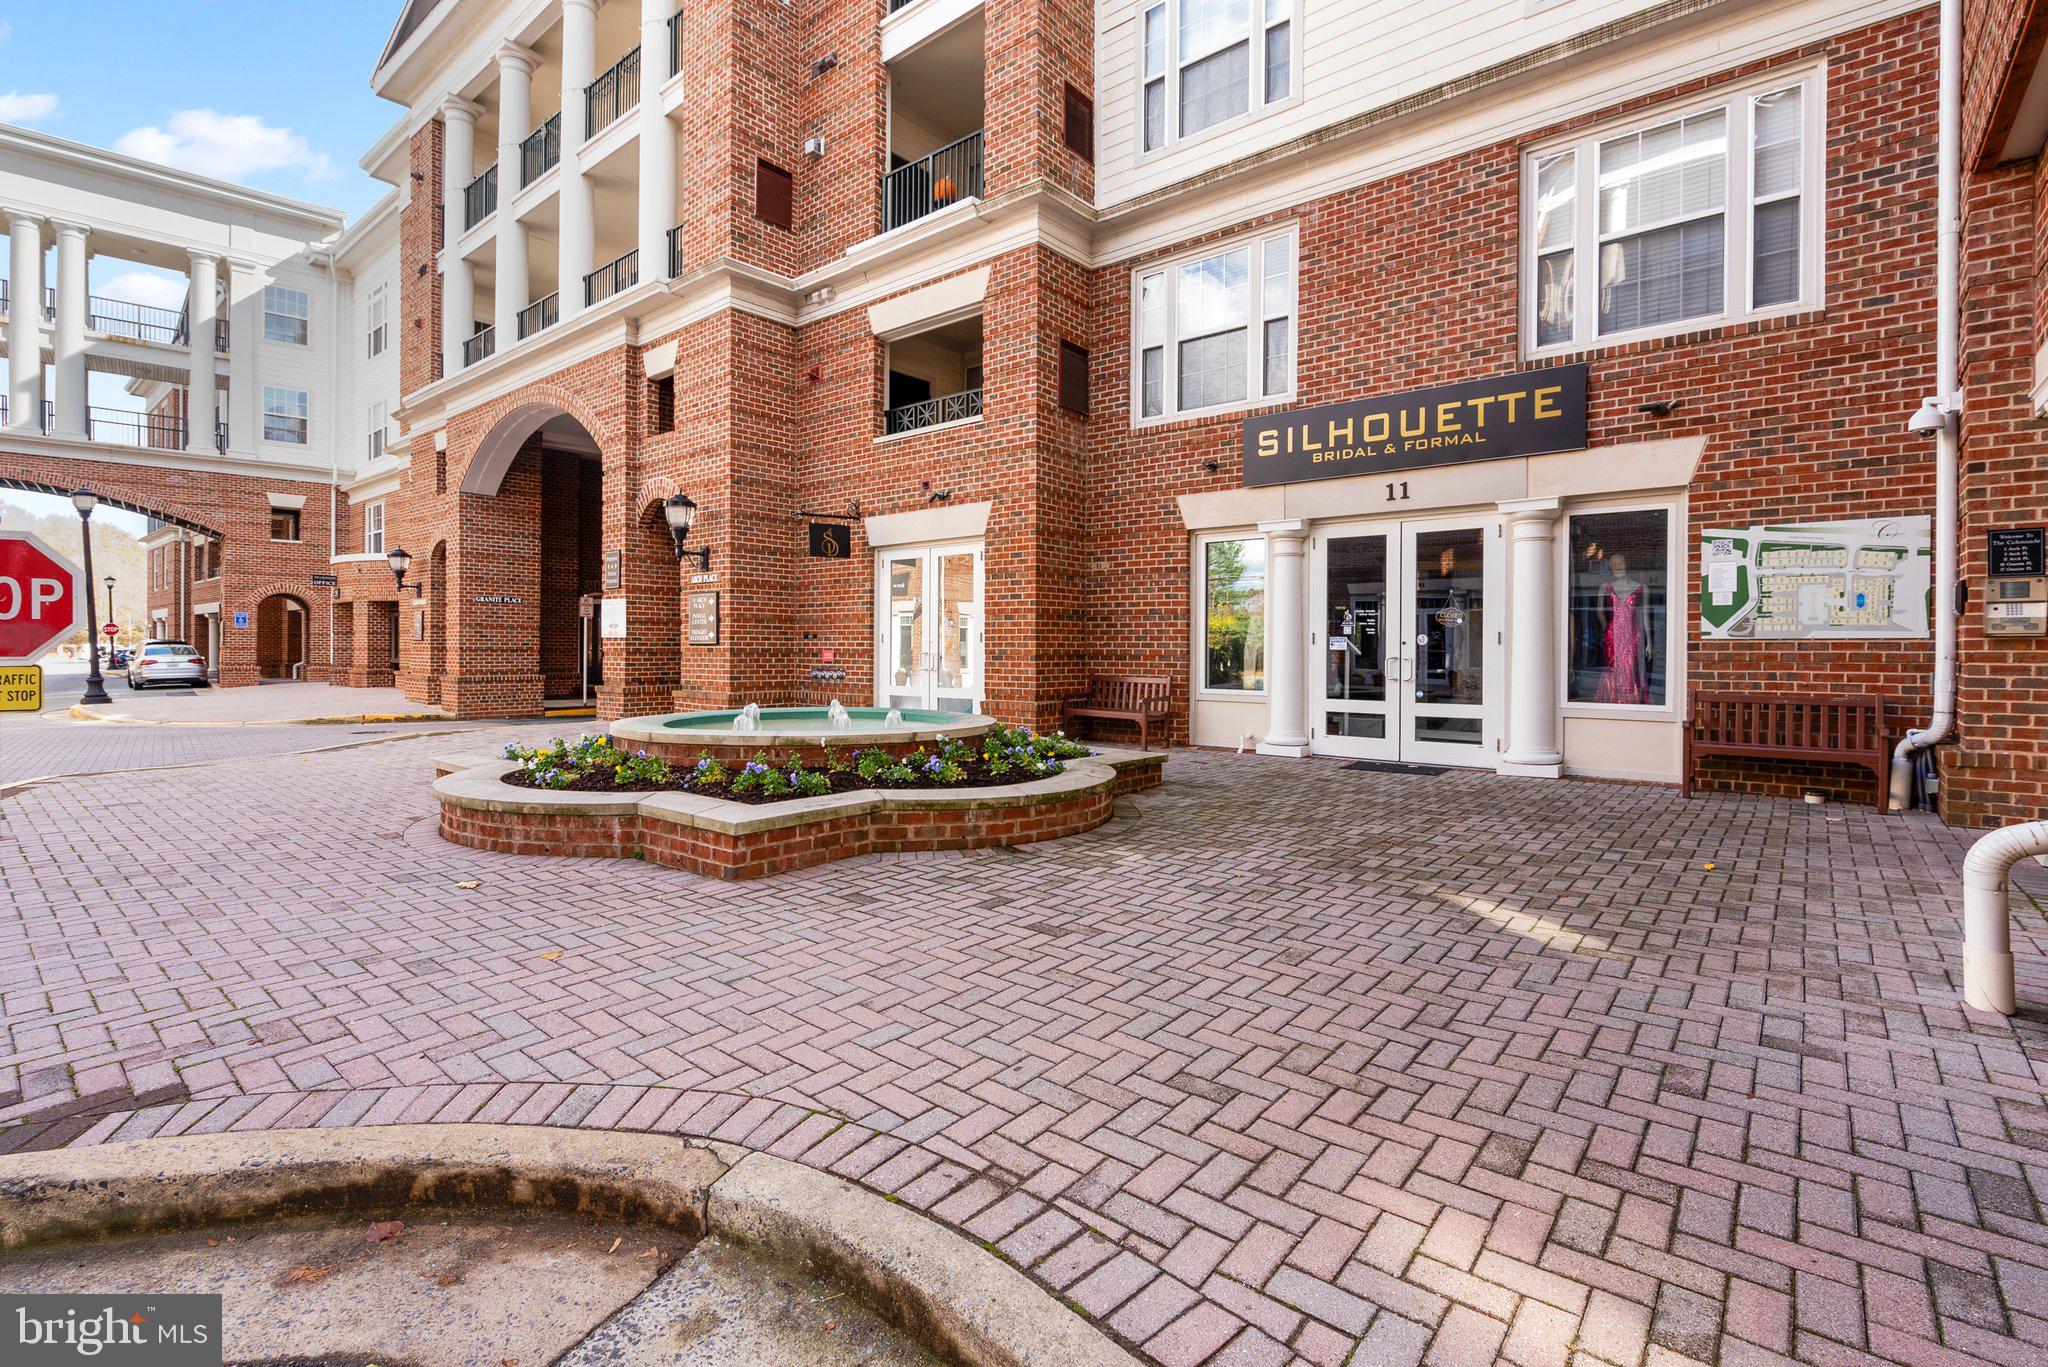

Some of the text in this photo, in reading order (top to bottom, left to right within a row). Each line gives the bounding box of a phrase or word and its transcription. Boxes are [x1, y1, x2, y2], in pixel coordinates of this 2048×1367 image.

[1257, 385, 1562, 457] SILHOUETTE
[1312, 432, 1486, 463] BRIDAL & FORMAL
[1385, 481, 1410, 501] 11
[703, 574, 718, 582] PLACE
[0, 575, 64, 620] OP
[1439, 611, 1463, 619] CLOSED
[7, 690, 36, 702] STOP
